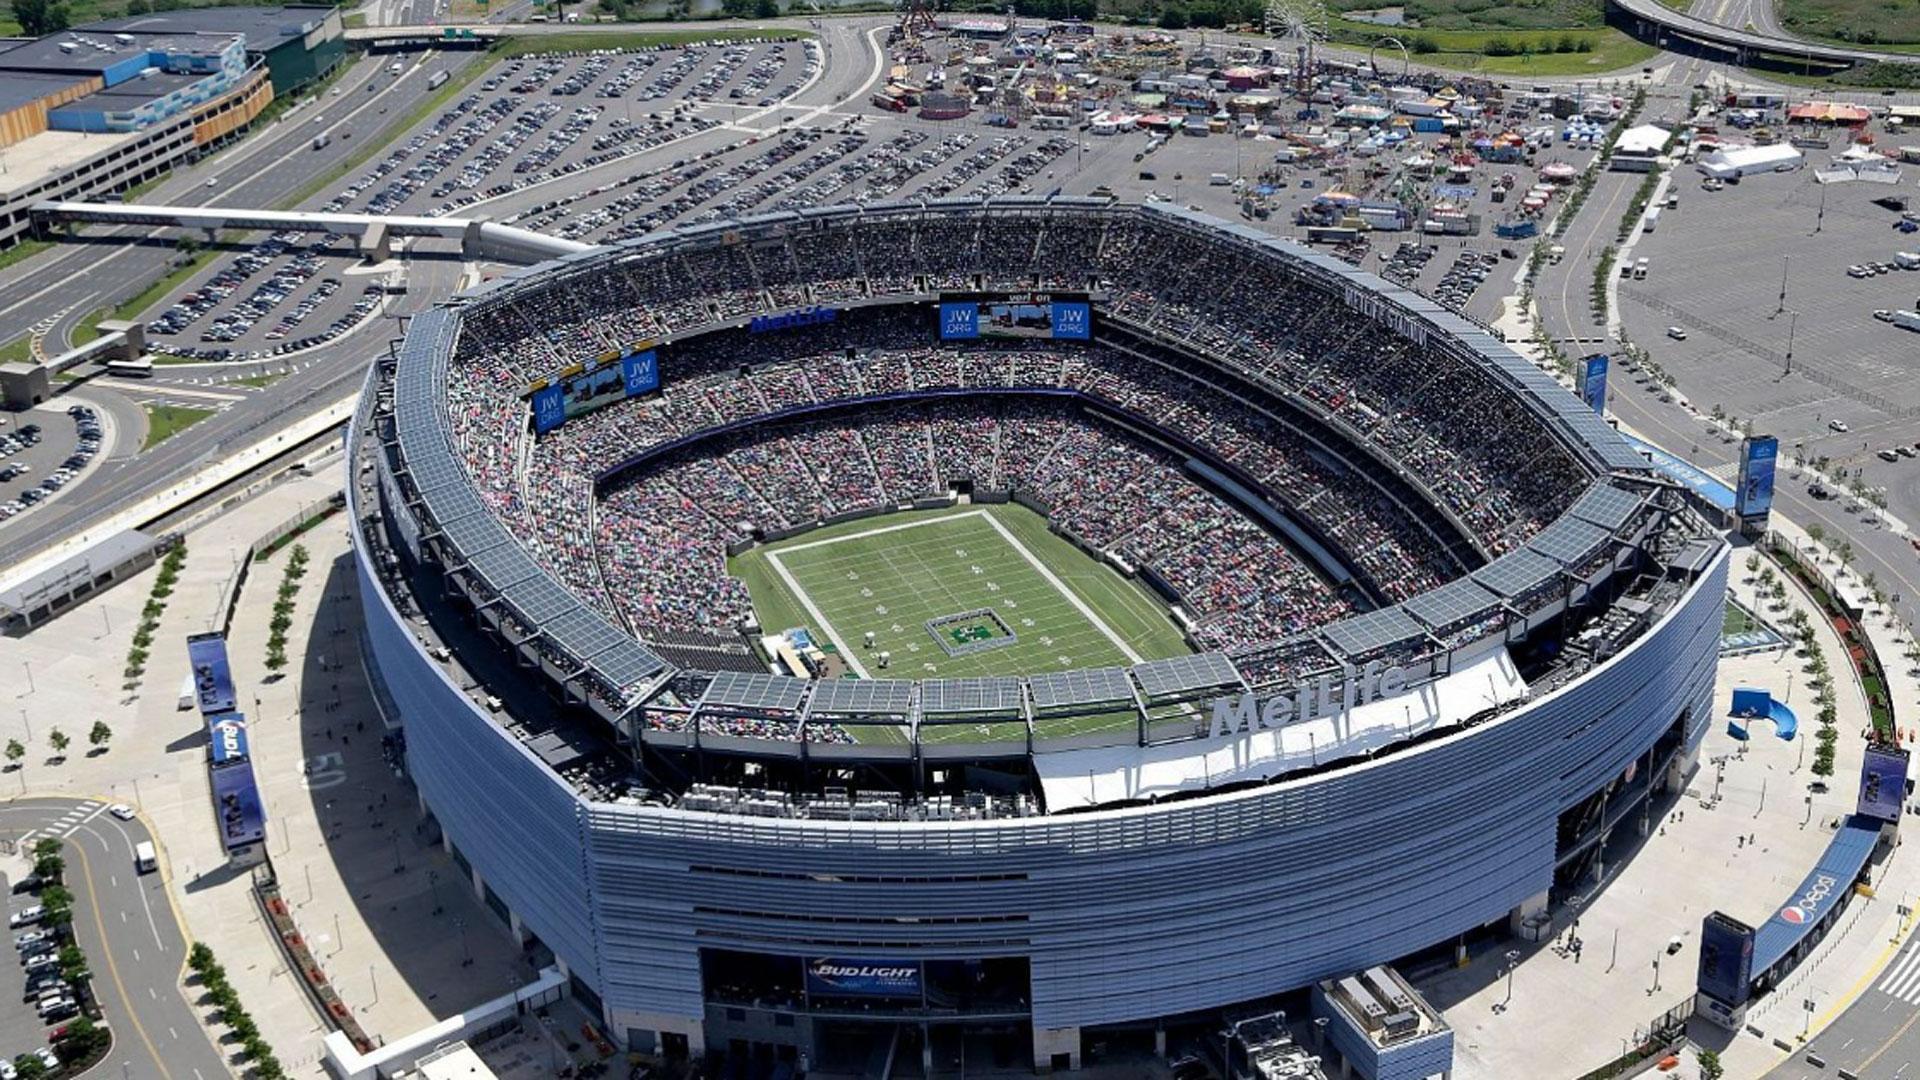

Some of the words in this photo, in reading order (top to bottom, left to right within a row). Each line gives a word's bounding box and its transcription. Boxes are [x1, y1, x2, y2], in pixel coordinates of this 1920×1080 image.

[1009, 292, 1050, 302] verion
[949, 310, 971, 323] JW
[1059, 310, 1083, 322] JW
[630, 359, 651, 378] JW
[541, 394, 559, 414] JW
[1209, 659, 1407, 740] MetLife
[223, 726, 239, 750] BUD
[1801, 875, 1836, 911] pepsi
[819, 965, 859, 976] BUD
[859, 967, 918, 978] LIGHT
